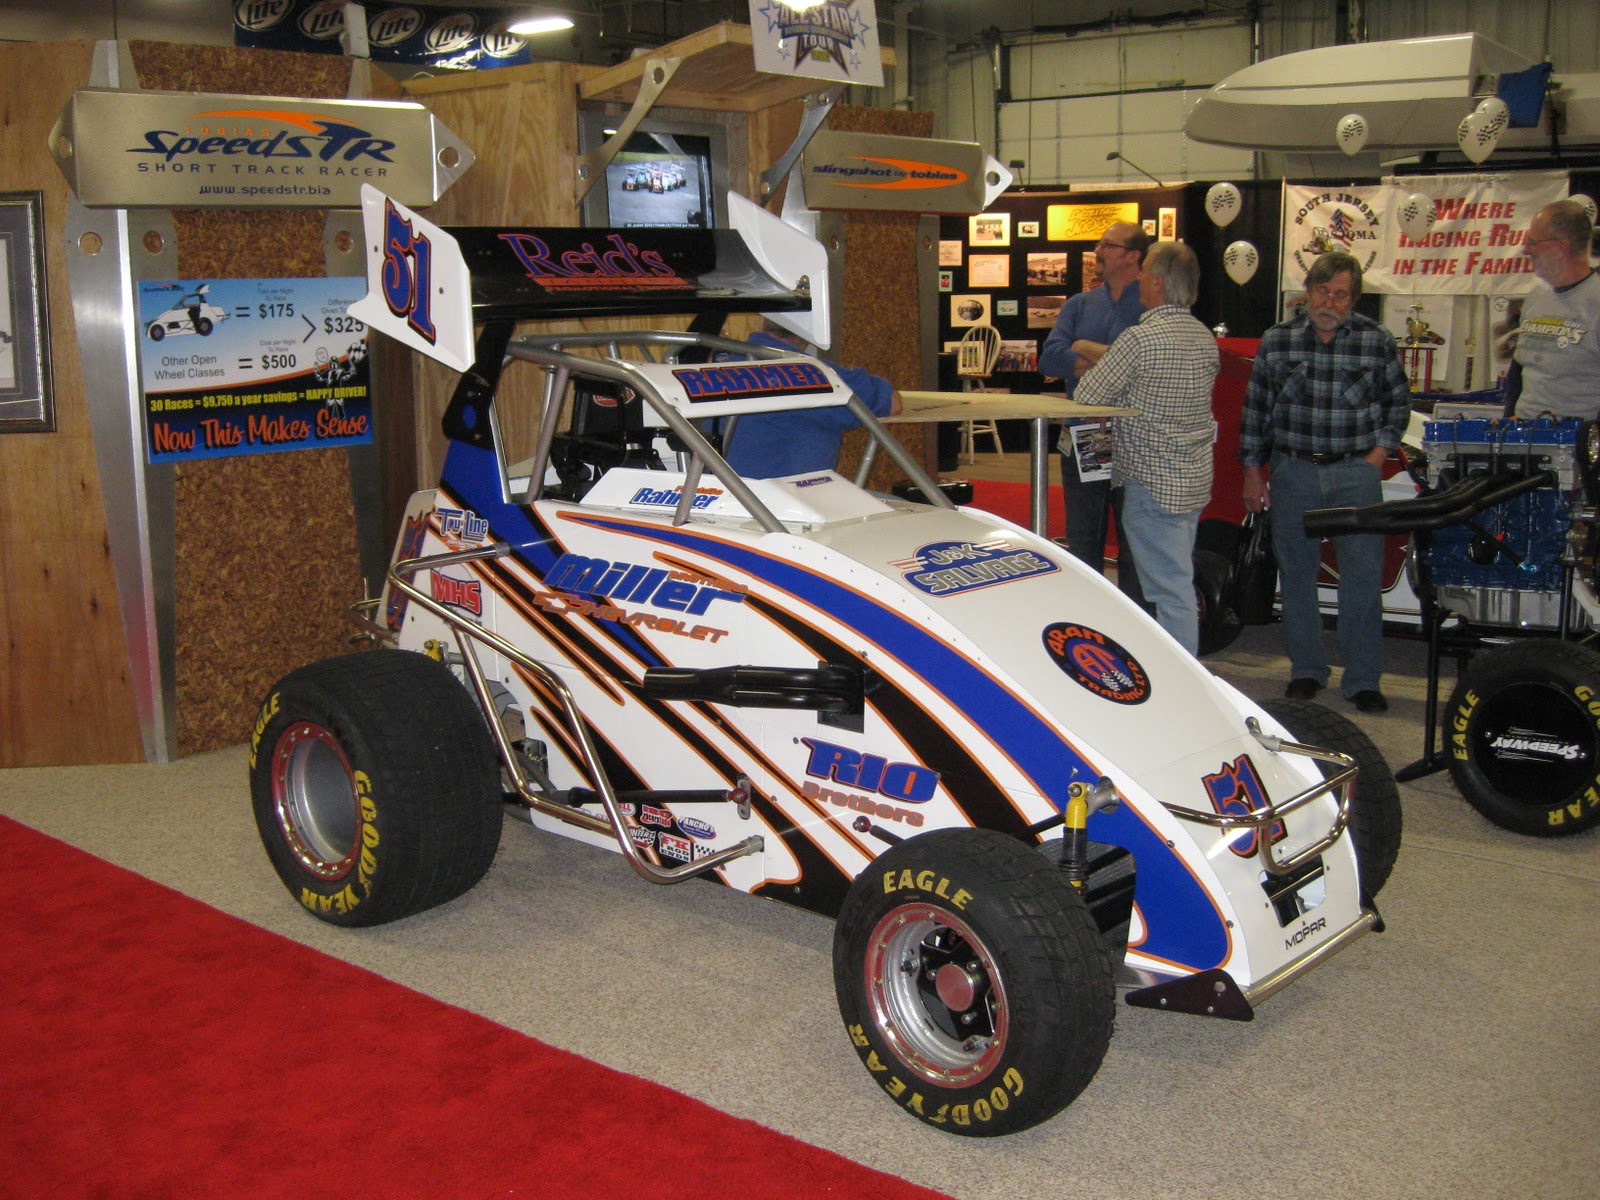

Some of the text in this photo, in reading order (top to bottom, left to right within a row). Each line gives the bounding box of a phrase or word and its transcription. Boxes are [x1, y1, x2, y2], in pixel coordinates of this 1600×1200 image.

[377, 16, 416, 42] Lite
[435, 19, 472, 50] Lite
[803, 34, 834, 50] TOUR
[184, 127, 272, 137] TOBIAS
[138, 162, 388, 177] SHORT TRACK RACER
[812, 162, 892, 177] slingshot
[910, 169, 958, 180] tobias
[200, 184, 331, 196] www.speedstr.biz
[1295, 193, 1380, 227] SOUTH JERSEY
[1432, 197, 1517, 221] WHERE
[497, 233, 678, 280] Reid's
[1392, 258, 1416, 275] IN
[1419, 258, 1458, 275] THE
[1464, 251, 1536, 275] FAMIL
[382, 196, 436, 345] 51
[259, 303, 294, 319] $175
[324, 316, 364, 335] $325
[154, 367, 226, 380] Wheel Classes
[162, 355, 217, 367] Other Open
[262, 354, 297, 369] $500
[672, 363, 834, 398] RAHMER
[151, 399, 164, 411] 30
[165, 398, 193, 410] Races
[202, 394, 233, 408] $9,750
[241, 394, 263, 406] year
[264, 390, 298, 404] savings
[306, 388, 333, 400] HAPPY
[334, 386, 367, 398] DRIVER!
[153, 408, 369, 451] Now This Makes Sense
[631, 488, 719, 508] Raher
[914, 543, 1051, 593] J&K SALVAGE
[431, 569, 482, 616] MHS
[567, 596, 729, 643] CHEVROLET
[1047, 626, 1105, 657] ARAN
[1078, 672, 1145, 701] TRADING
[250, 691, 281, 770] EAGLE
[1452, 688, 1481, 761] EAGLE
[1490, 736, 1579, 760] SPEEDWAY
[800, 737, 941, 804] RIO
[801, 781, 925, 828] Brothers
[679, 815, 716, 833] PANCHO'S
[660, 848, 689, 861] ENDS
[662, 836, 689, 850] FK
[667, 845, 689, 856] ROD
[882, 868, 974, 911] EAGLE
[1285, 917, 1327, 950] MOPAR
[848, 1023, 1025, 1127] GOODYEAR
